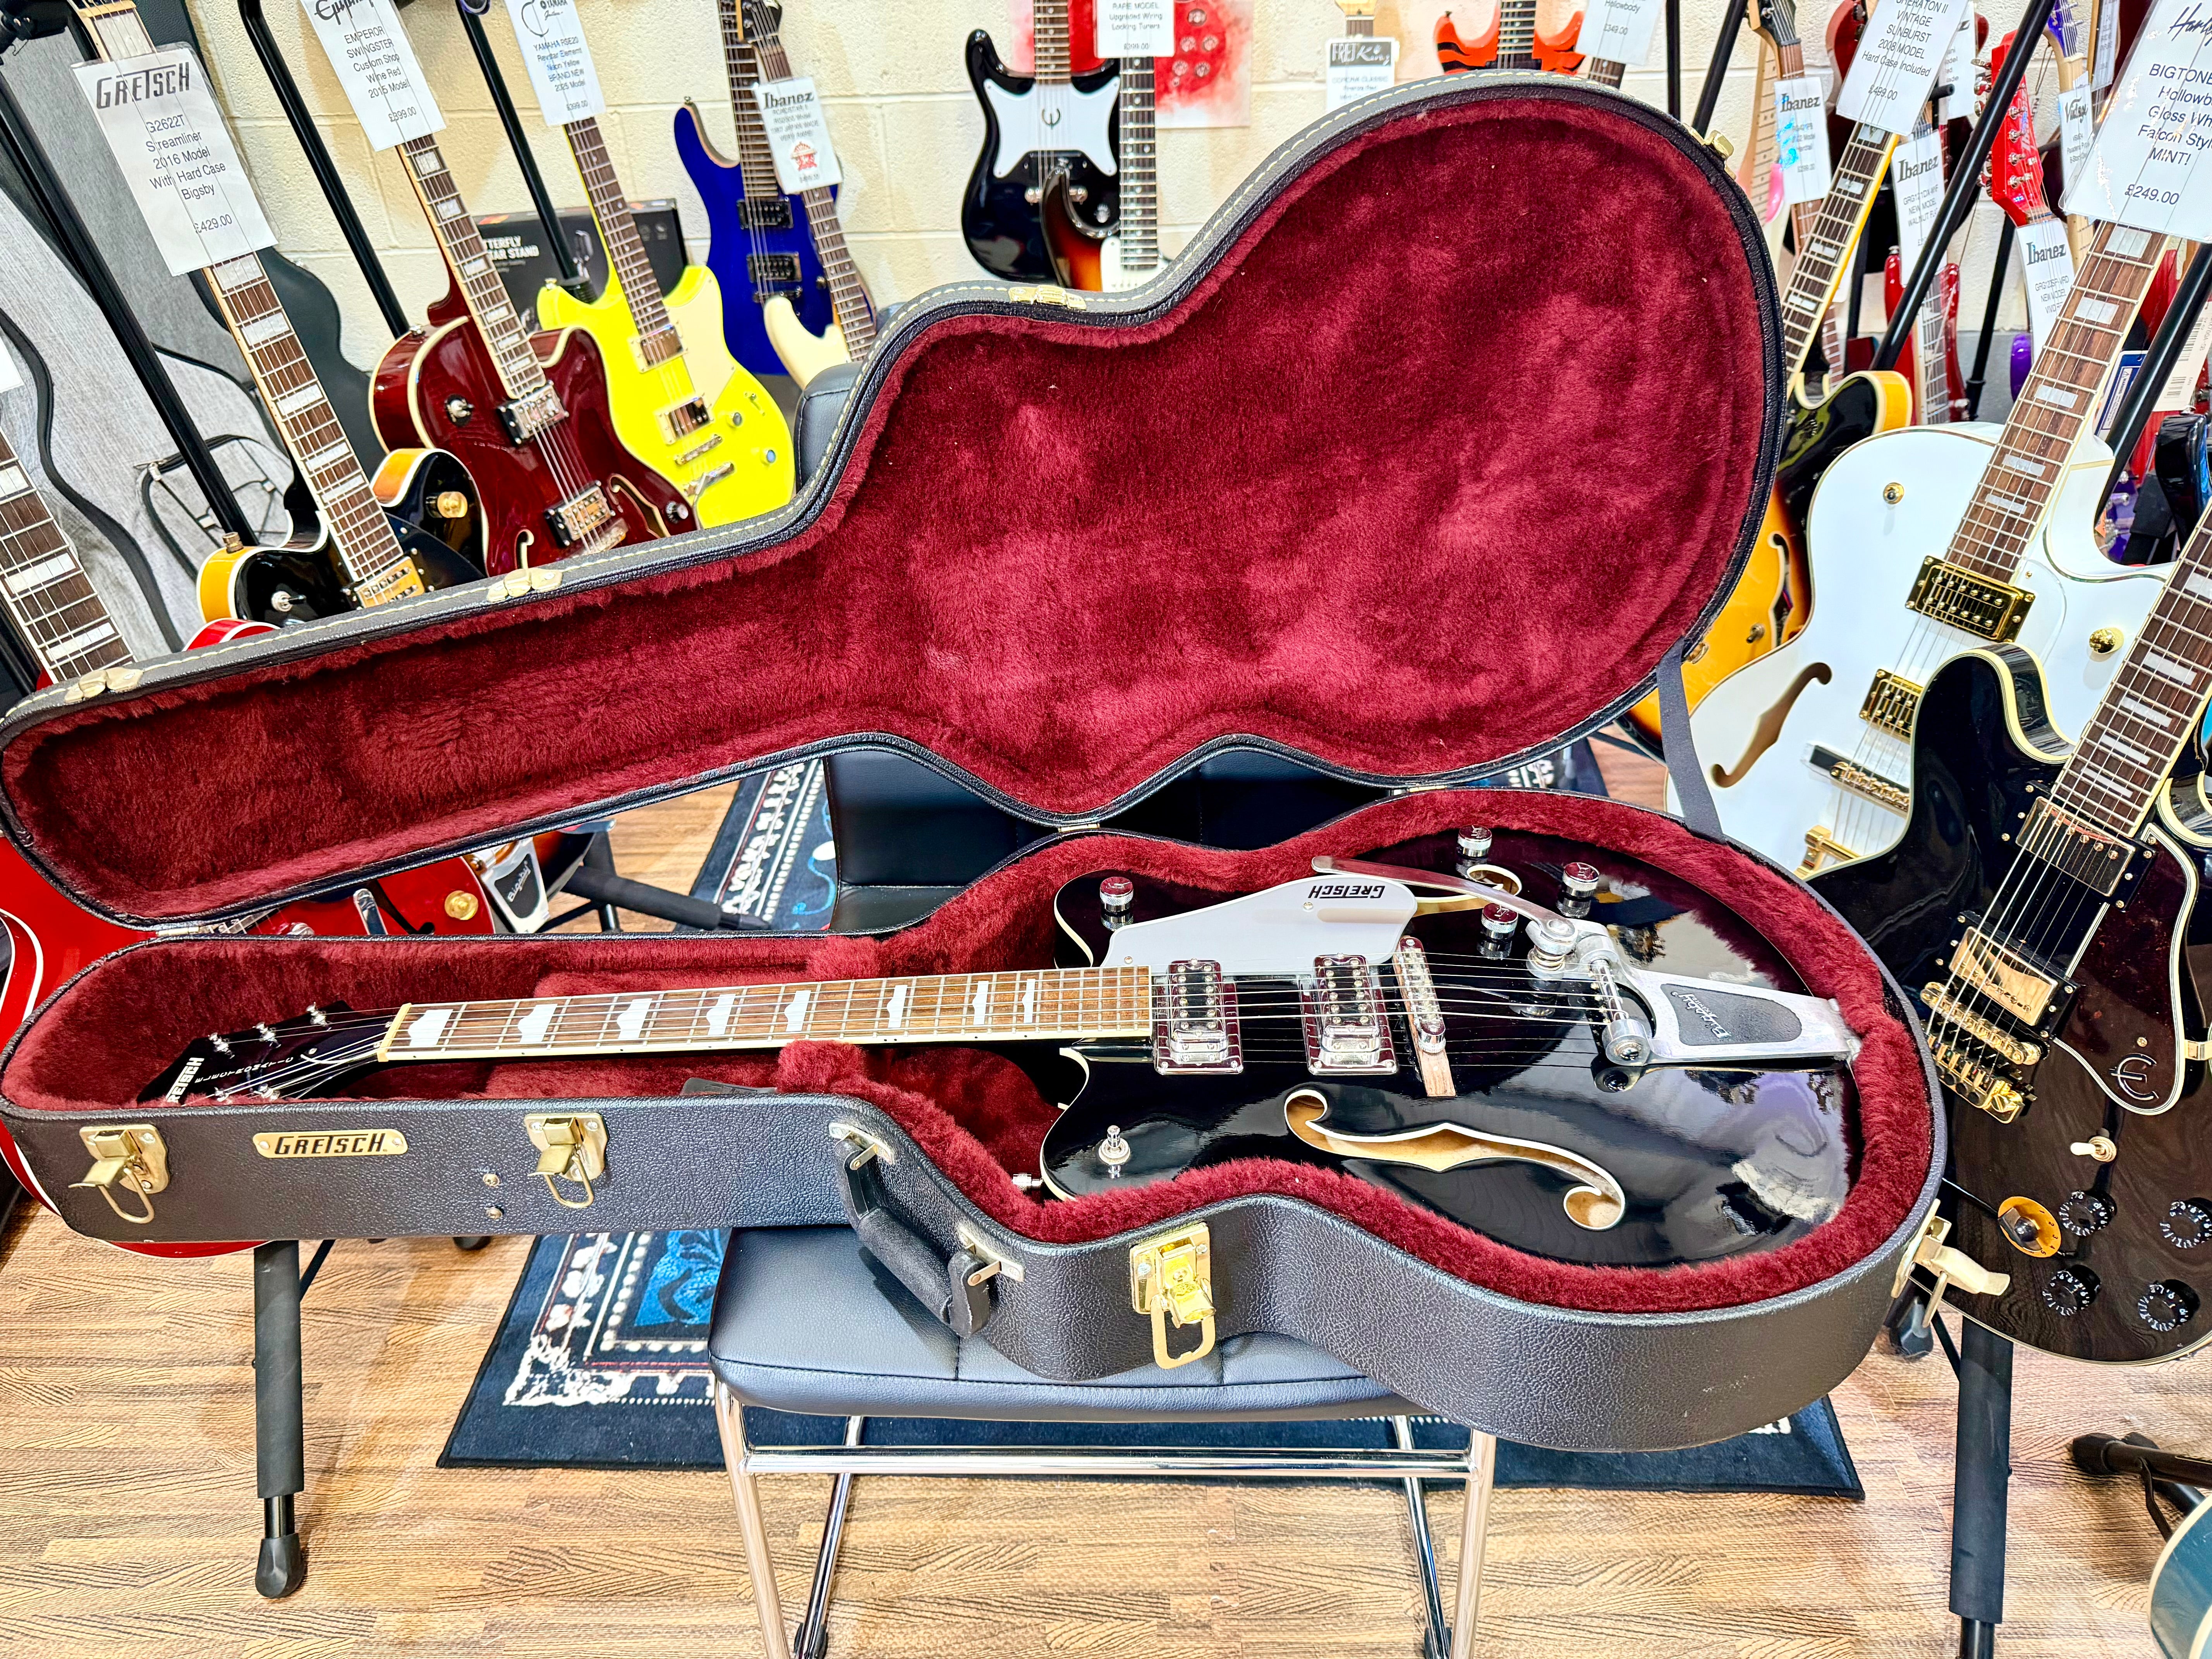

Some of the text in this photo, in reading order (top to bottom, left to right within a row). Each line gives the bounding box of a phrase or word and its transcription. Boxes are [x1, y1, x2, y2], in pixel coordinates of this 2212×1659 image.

[1897, 10, 1933, 27] VINTAGE
[344, 26, 385, 44] EMPEROR
[1886, 24, 1931, 43] SUNBURST
[347, 38, 394, 58] SWINGSTER
[533, 40, 560, 51] YAMAHA
[1878, 39, 1925, 59] 2008 MODEL
[353, 53, 400, 71] Custom Shop
[1862, 51, 1931, 77] Hard Case Included
[366, 67, 401, 83] Wine Red
[2149, 64, 2212, 85] BIGTONE
[96, 62, 190, 109] GRETSCH
[368, 85, 388, 98] 2015
[1868, 84, 1898, 100] £499.00
[762, 92, 814, 110] Ibanez
[1780, 93, 1820, 113] Ibanez
[2158, 86, 2212, 106] Hollowb
[146, 114, 185, 133] G2622T
[388, 106, 416, 122] £399.00
[2148, 105, 2186, 123] Gloss
[2138, 124, 2212, 150] Falcon Styl
[153, 146, 211, 170] 2016 Model
[2148, 148, 2191, 165] MINT!
[149, 163, 226, 189] With Hard Case
[1897, 155, 1939, 183] Ibanez
[181, 184, 215, 200] Bigsby
[2124, 184, 2179, 205] £249.00
[1908, 206, 1921, 215] NEW
[194, 214, 232, 234] £429.00
[483, 235, 521, 250] TTERFLY
[487, 245, 539, 260] TAR STAND
[2026, 241, 2066, 265] Ibanez
[2041, 289, 2066, 303] NEW MODEL
[1308, 885, 1385, 899] GRETSCH
[1678, 993, 1732, 1038] Bigsby
[194, 1057, 294, 1083] ELECTROMATIC
[166, 1057, 204, 1103] RETSCH
[275, 1133, 386, 1154] GRETSCH
